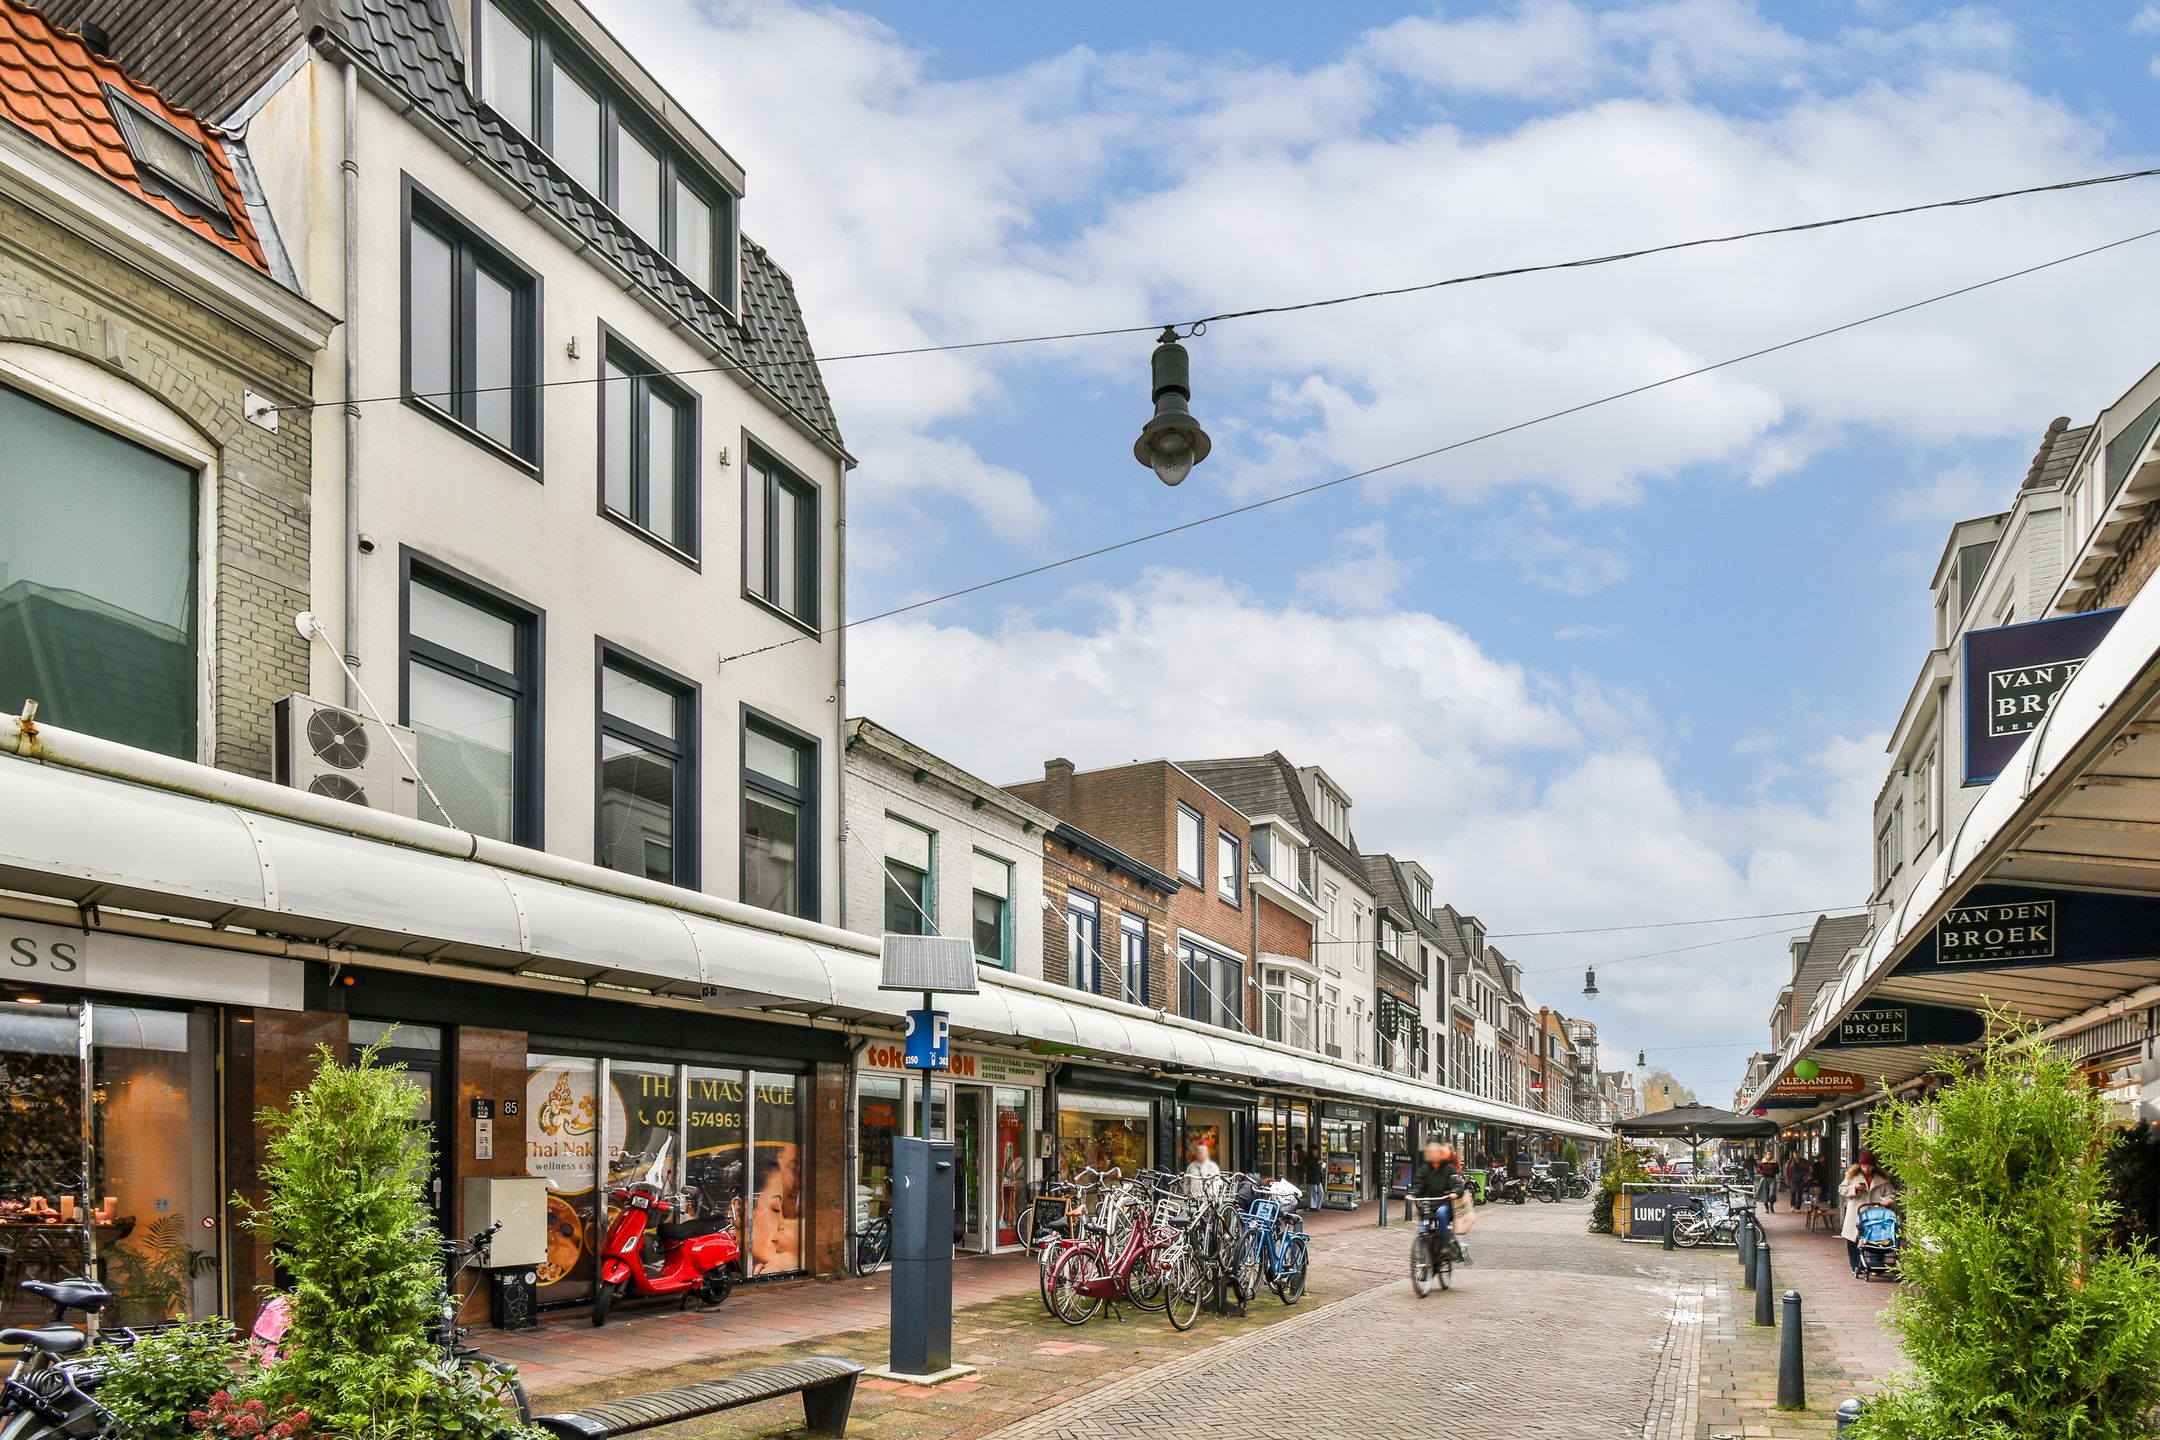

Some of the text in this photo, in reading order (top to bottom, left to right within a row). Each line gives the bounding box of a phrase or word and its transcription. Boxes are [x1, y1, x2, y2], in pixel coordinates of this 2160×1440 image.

[1996, 668, 2054, 689] VAN
[1944, 904, 2048, 925] VAN DEN
[1943, 925, 2049, 948] BROEK
[1845, 1011, 1903, 1021] VAN DEN
[933, 1015, 948, 1048] P
[1844, 1022, 1903, 1034] BROEK
[982, 1064, 1035, 1076] OOSTERSE PRODUCTEN
[1023, 1061, 1044, 1069] CENTRUM
[982, 1072, 1006, 1081] CATERING
[504, 1102, 517, 1114] 85
[526, 1141, 558, 1157] Thai
[535, 1161, 576, 1170] wellness
